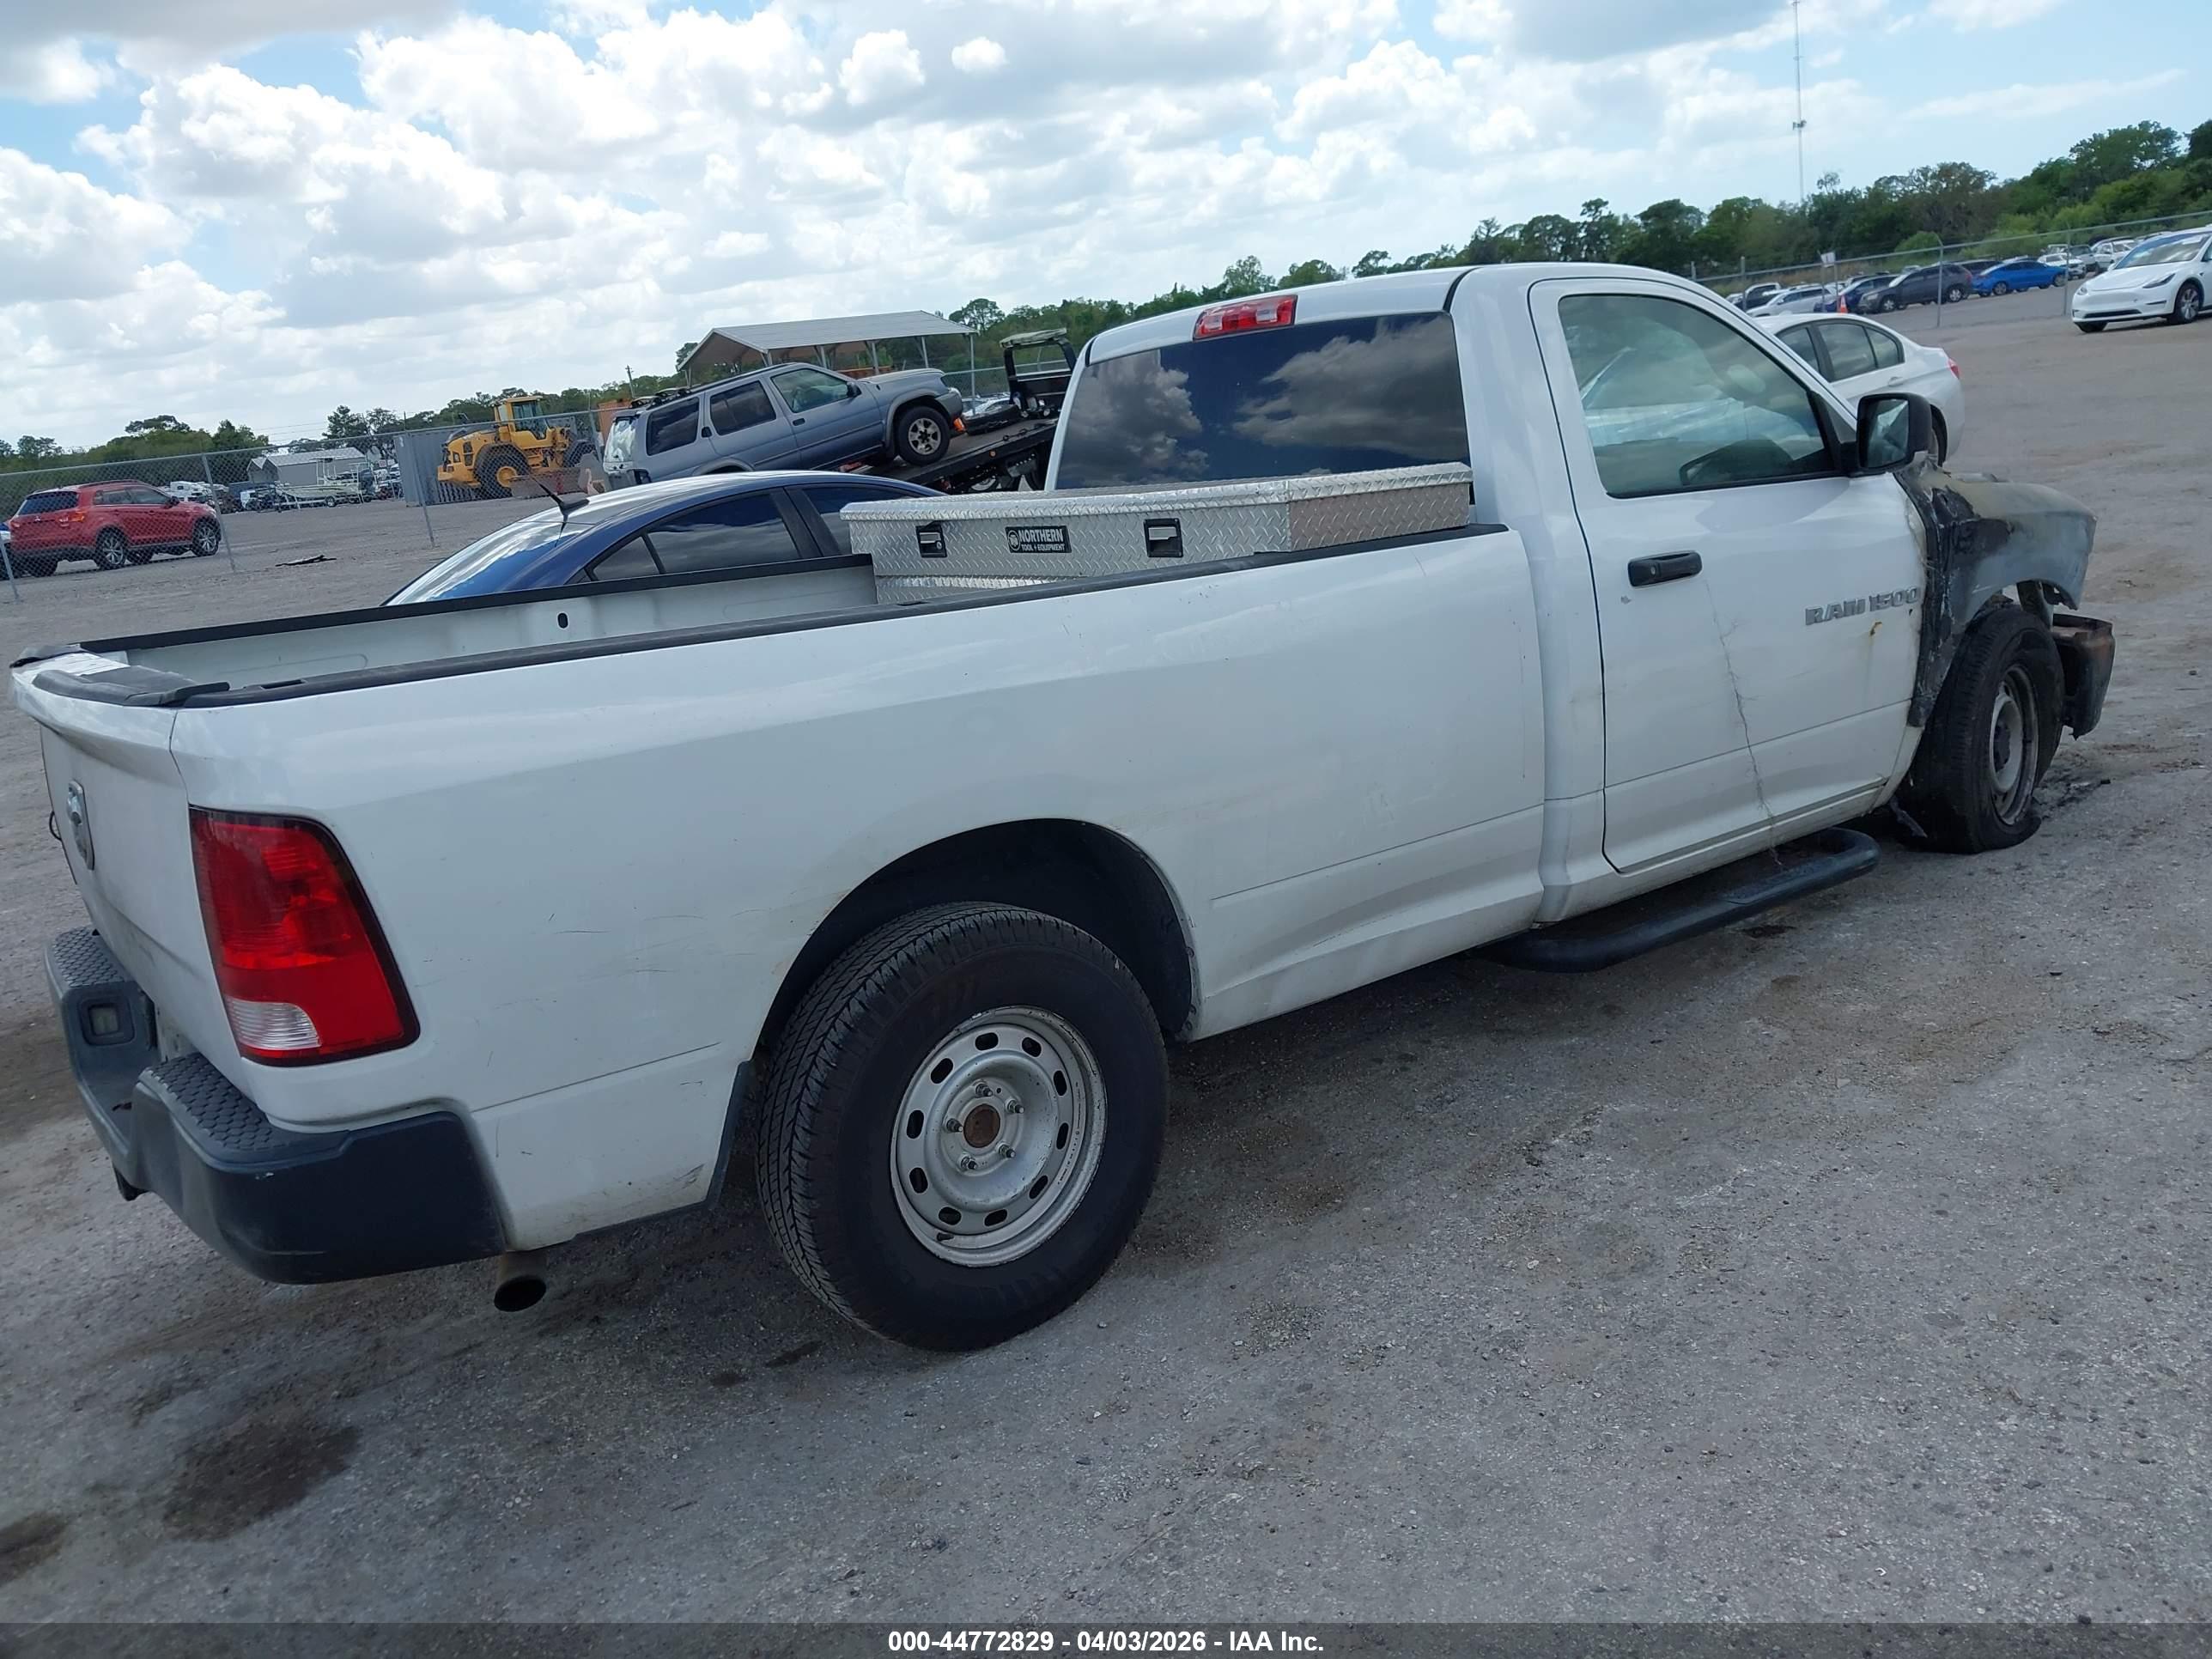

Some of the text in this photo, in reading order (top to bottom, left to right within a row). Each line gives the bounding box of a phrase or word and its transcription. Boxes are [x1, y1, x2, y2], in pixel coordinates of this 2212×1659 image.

[1018, 528, 1064, 543] NORTHERN
[1037, 543, 1065, 551] EQUIPMENT
[1805, 586, 1921, 626] RAM 1500
